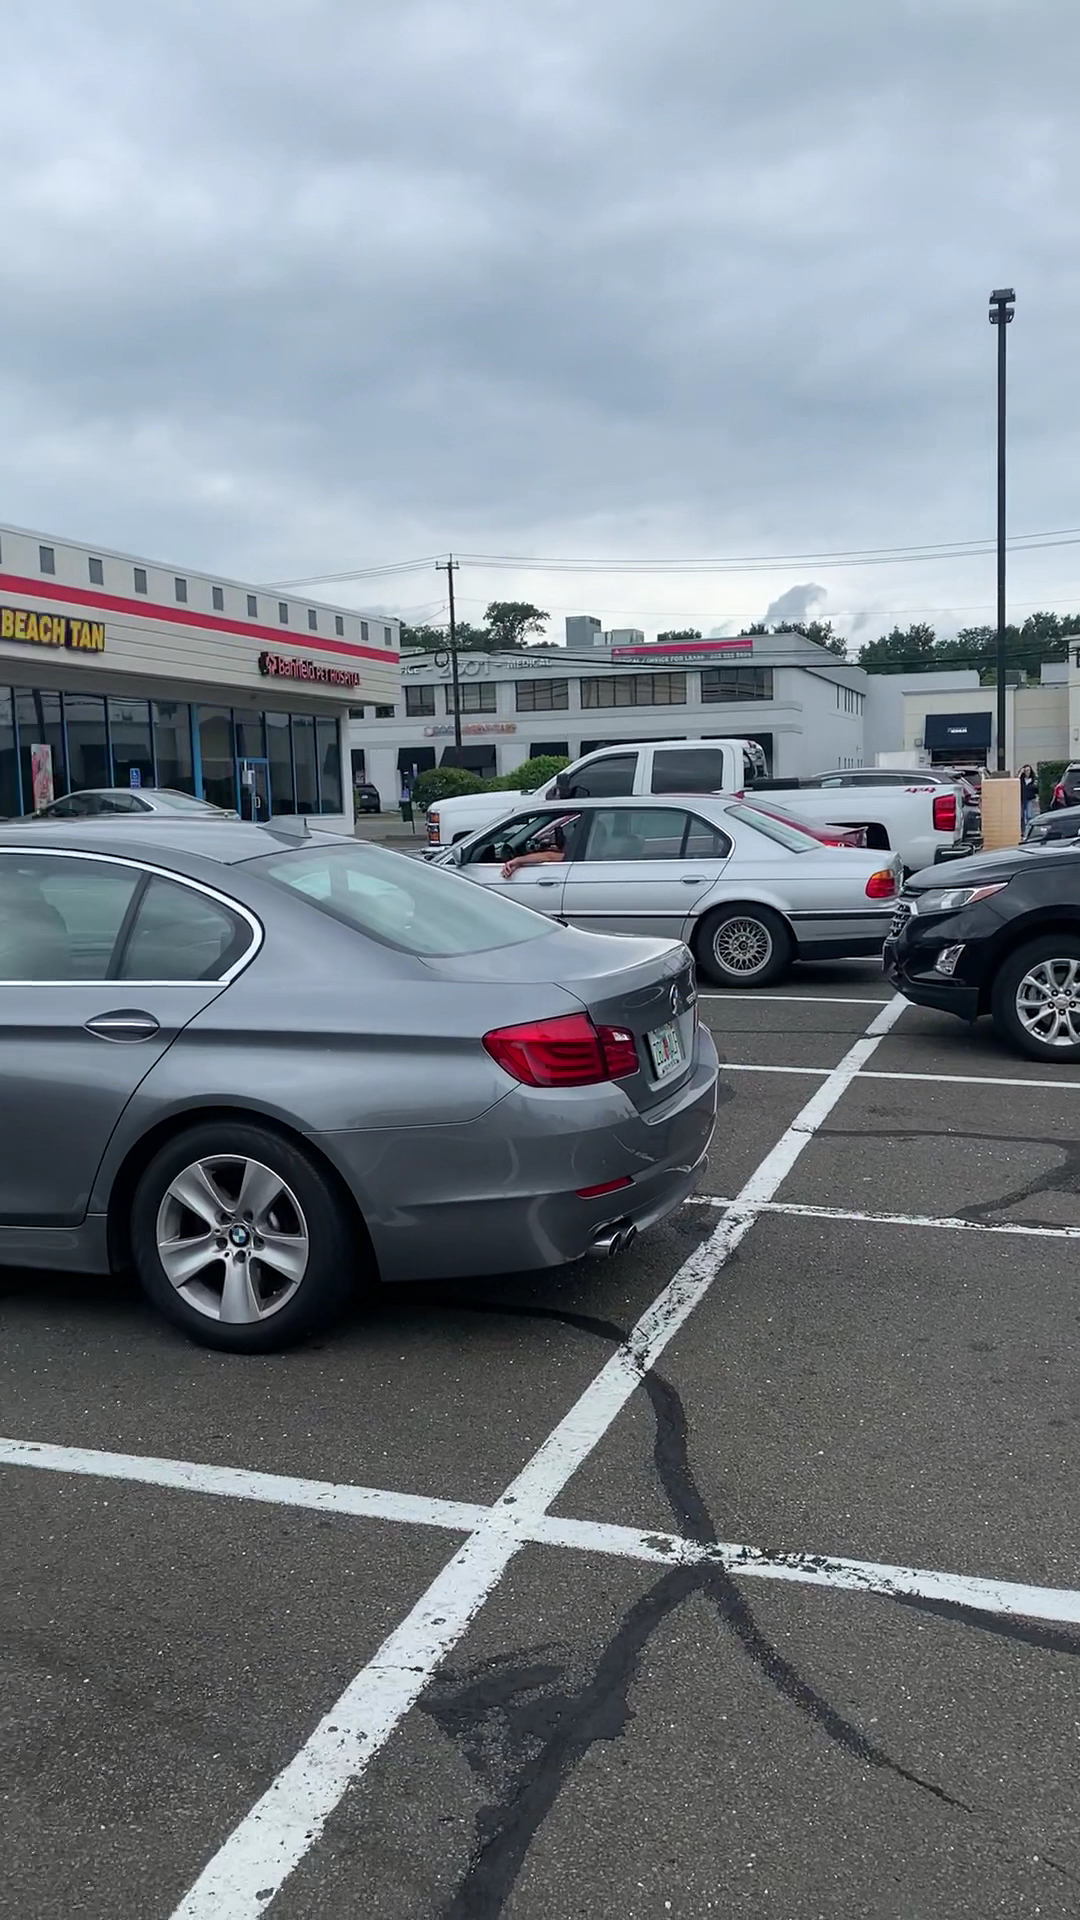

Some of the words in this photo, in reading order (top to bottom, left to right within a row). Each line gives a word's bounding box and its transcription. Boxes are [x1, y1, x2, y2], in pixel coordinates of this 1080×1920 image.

[1, 608, 66, 645] BEACH
[70, 620, 104, 649] TAN
[507, 659, 552, 669] MEDICAL
